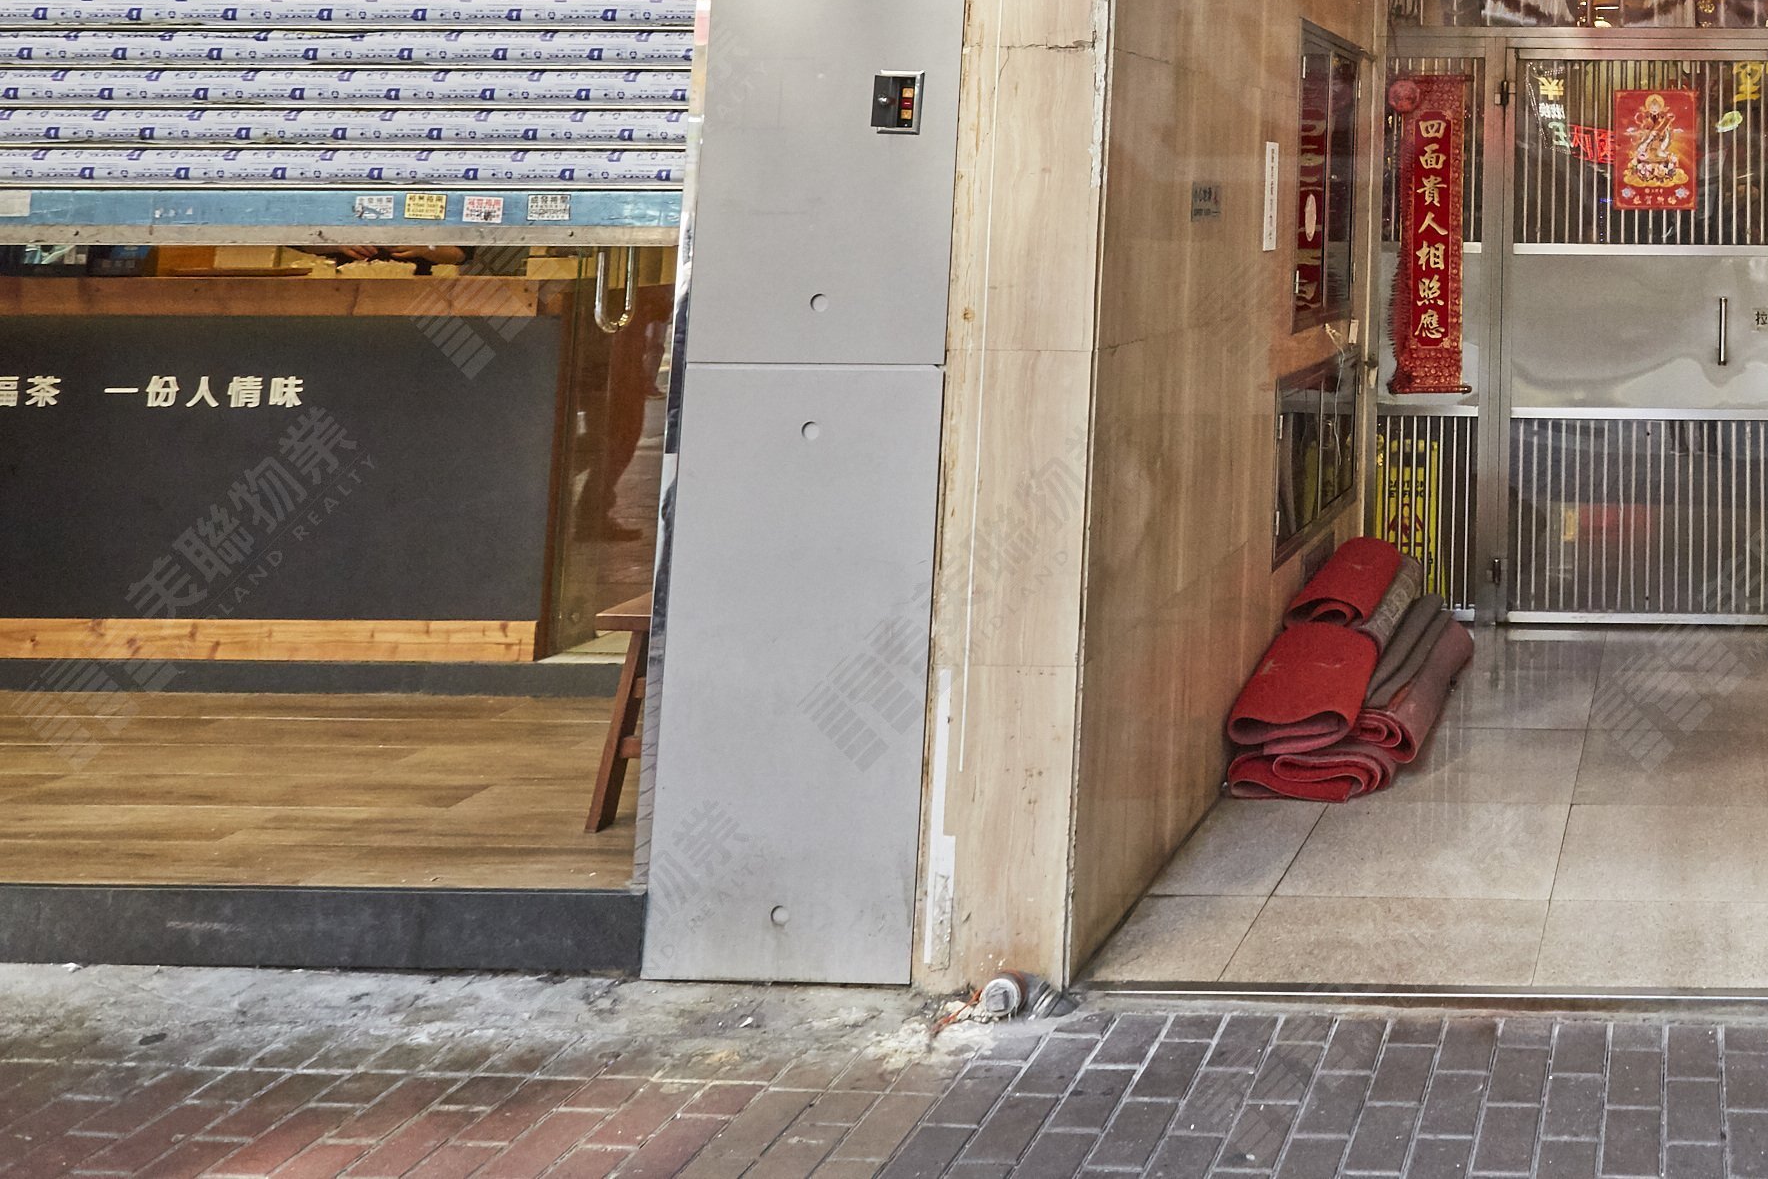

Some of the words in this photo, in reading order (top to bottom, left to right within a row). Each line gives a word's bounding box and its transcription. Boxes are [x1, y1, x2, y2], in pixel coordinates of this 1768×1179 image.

[1414, 119, 1449, 339] 四面貴人相照應
[104, 376, 304, 408] 一份人情味
